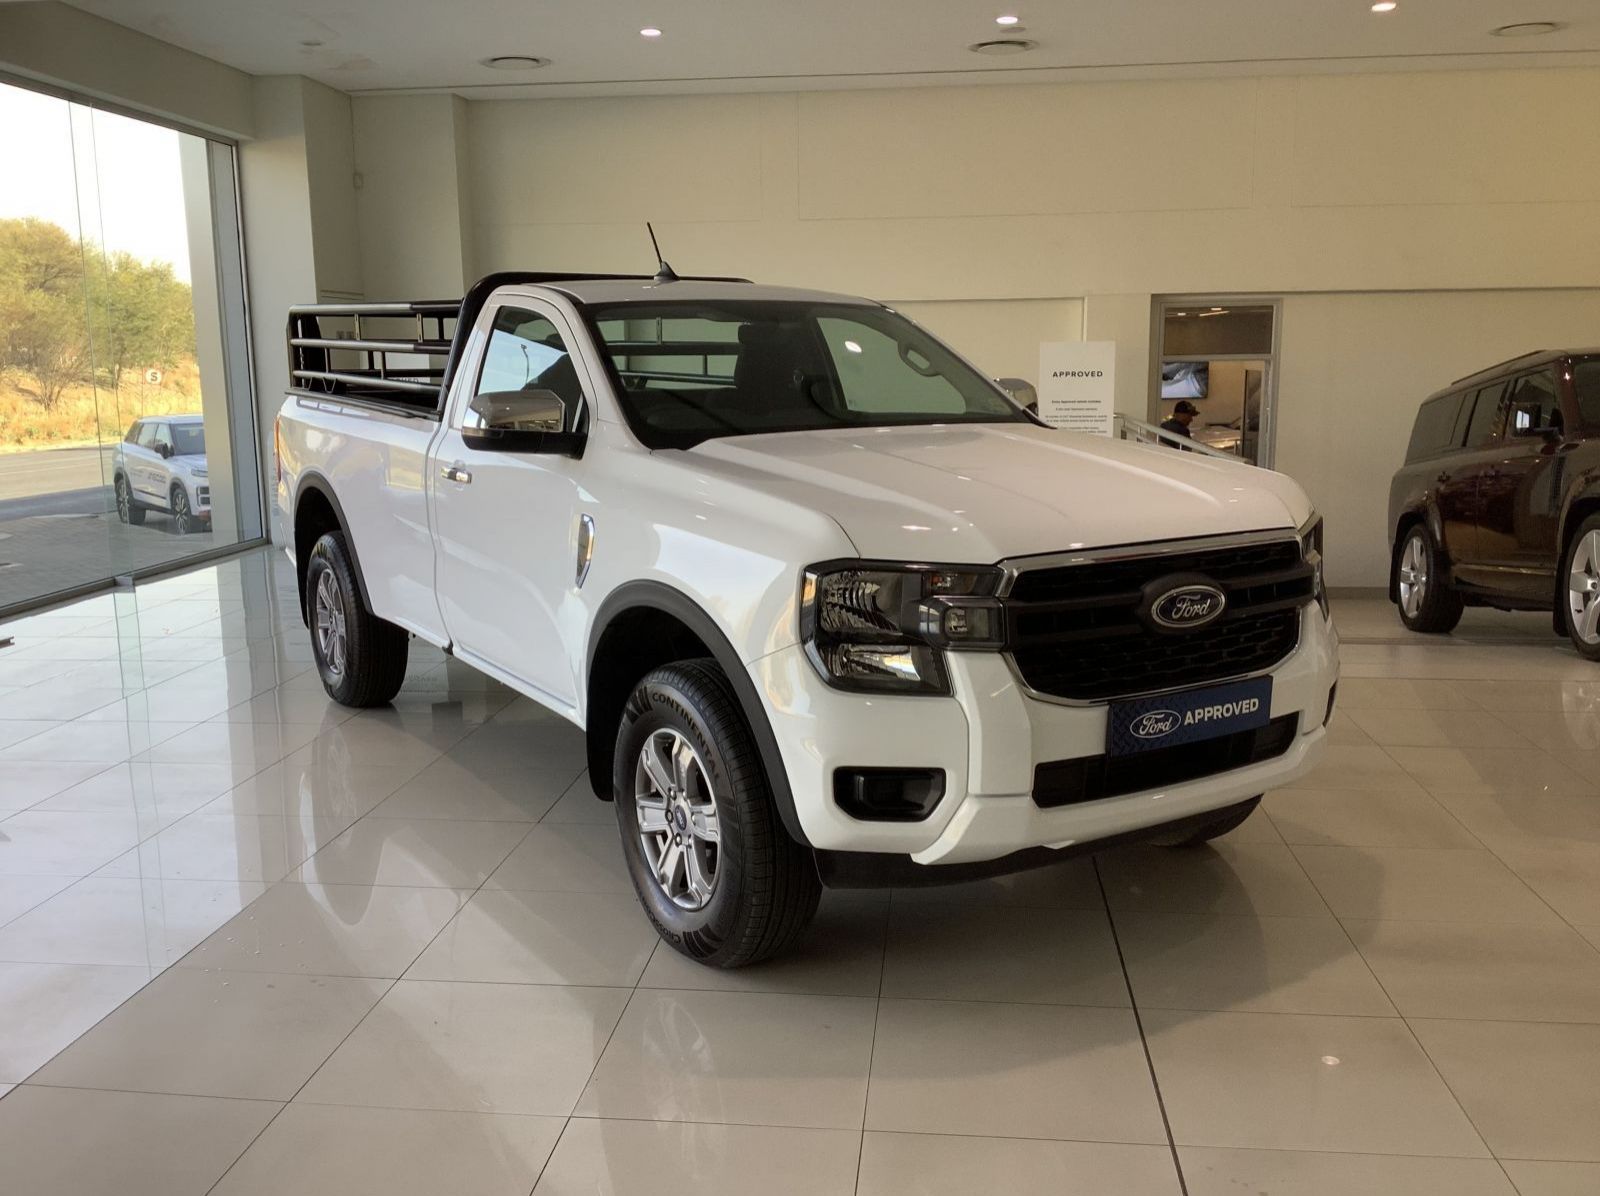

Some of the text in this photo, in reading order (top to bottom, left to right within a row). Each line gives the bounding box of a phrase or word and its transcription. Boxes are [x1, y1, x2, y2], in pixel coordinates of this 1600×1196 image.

[150, 372, 158, 382] S
[1052, 370, 1103, 378] APPROVED
[1171, 594, 1211, 620] Ford
[1139, 698, 1259, 735] Ford APPROVED
[652, 692, 720, 783] CONTINENTAL
